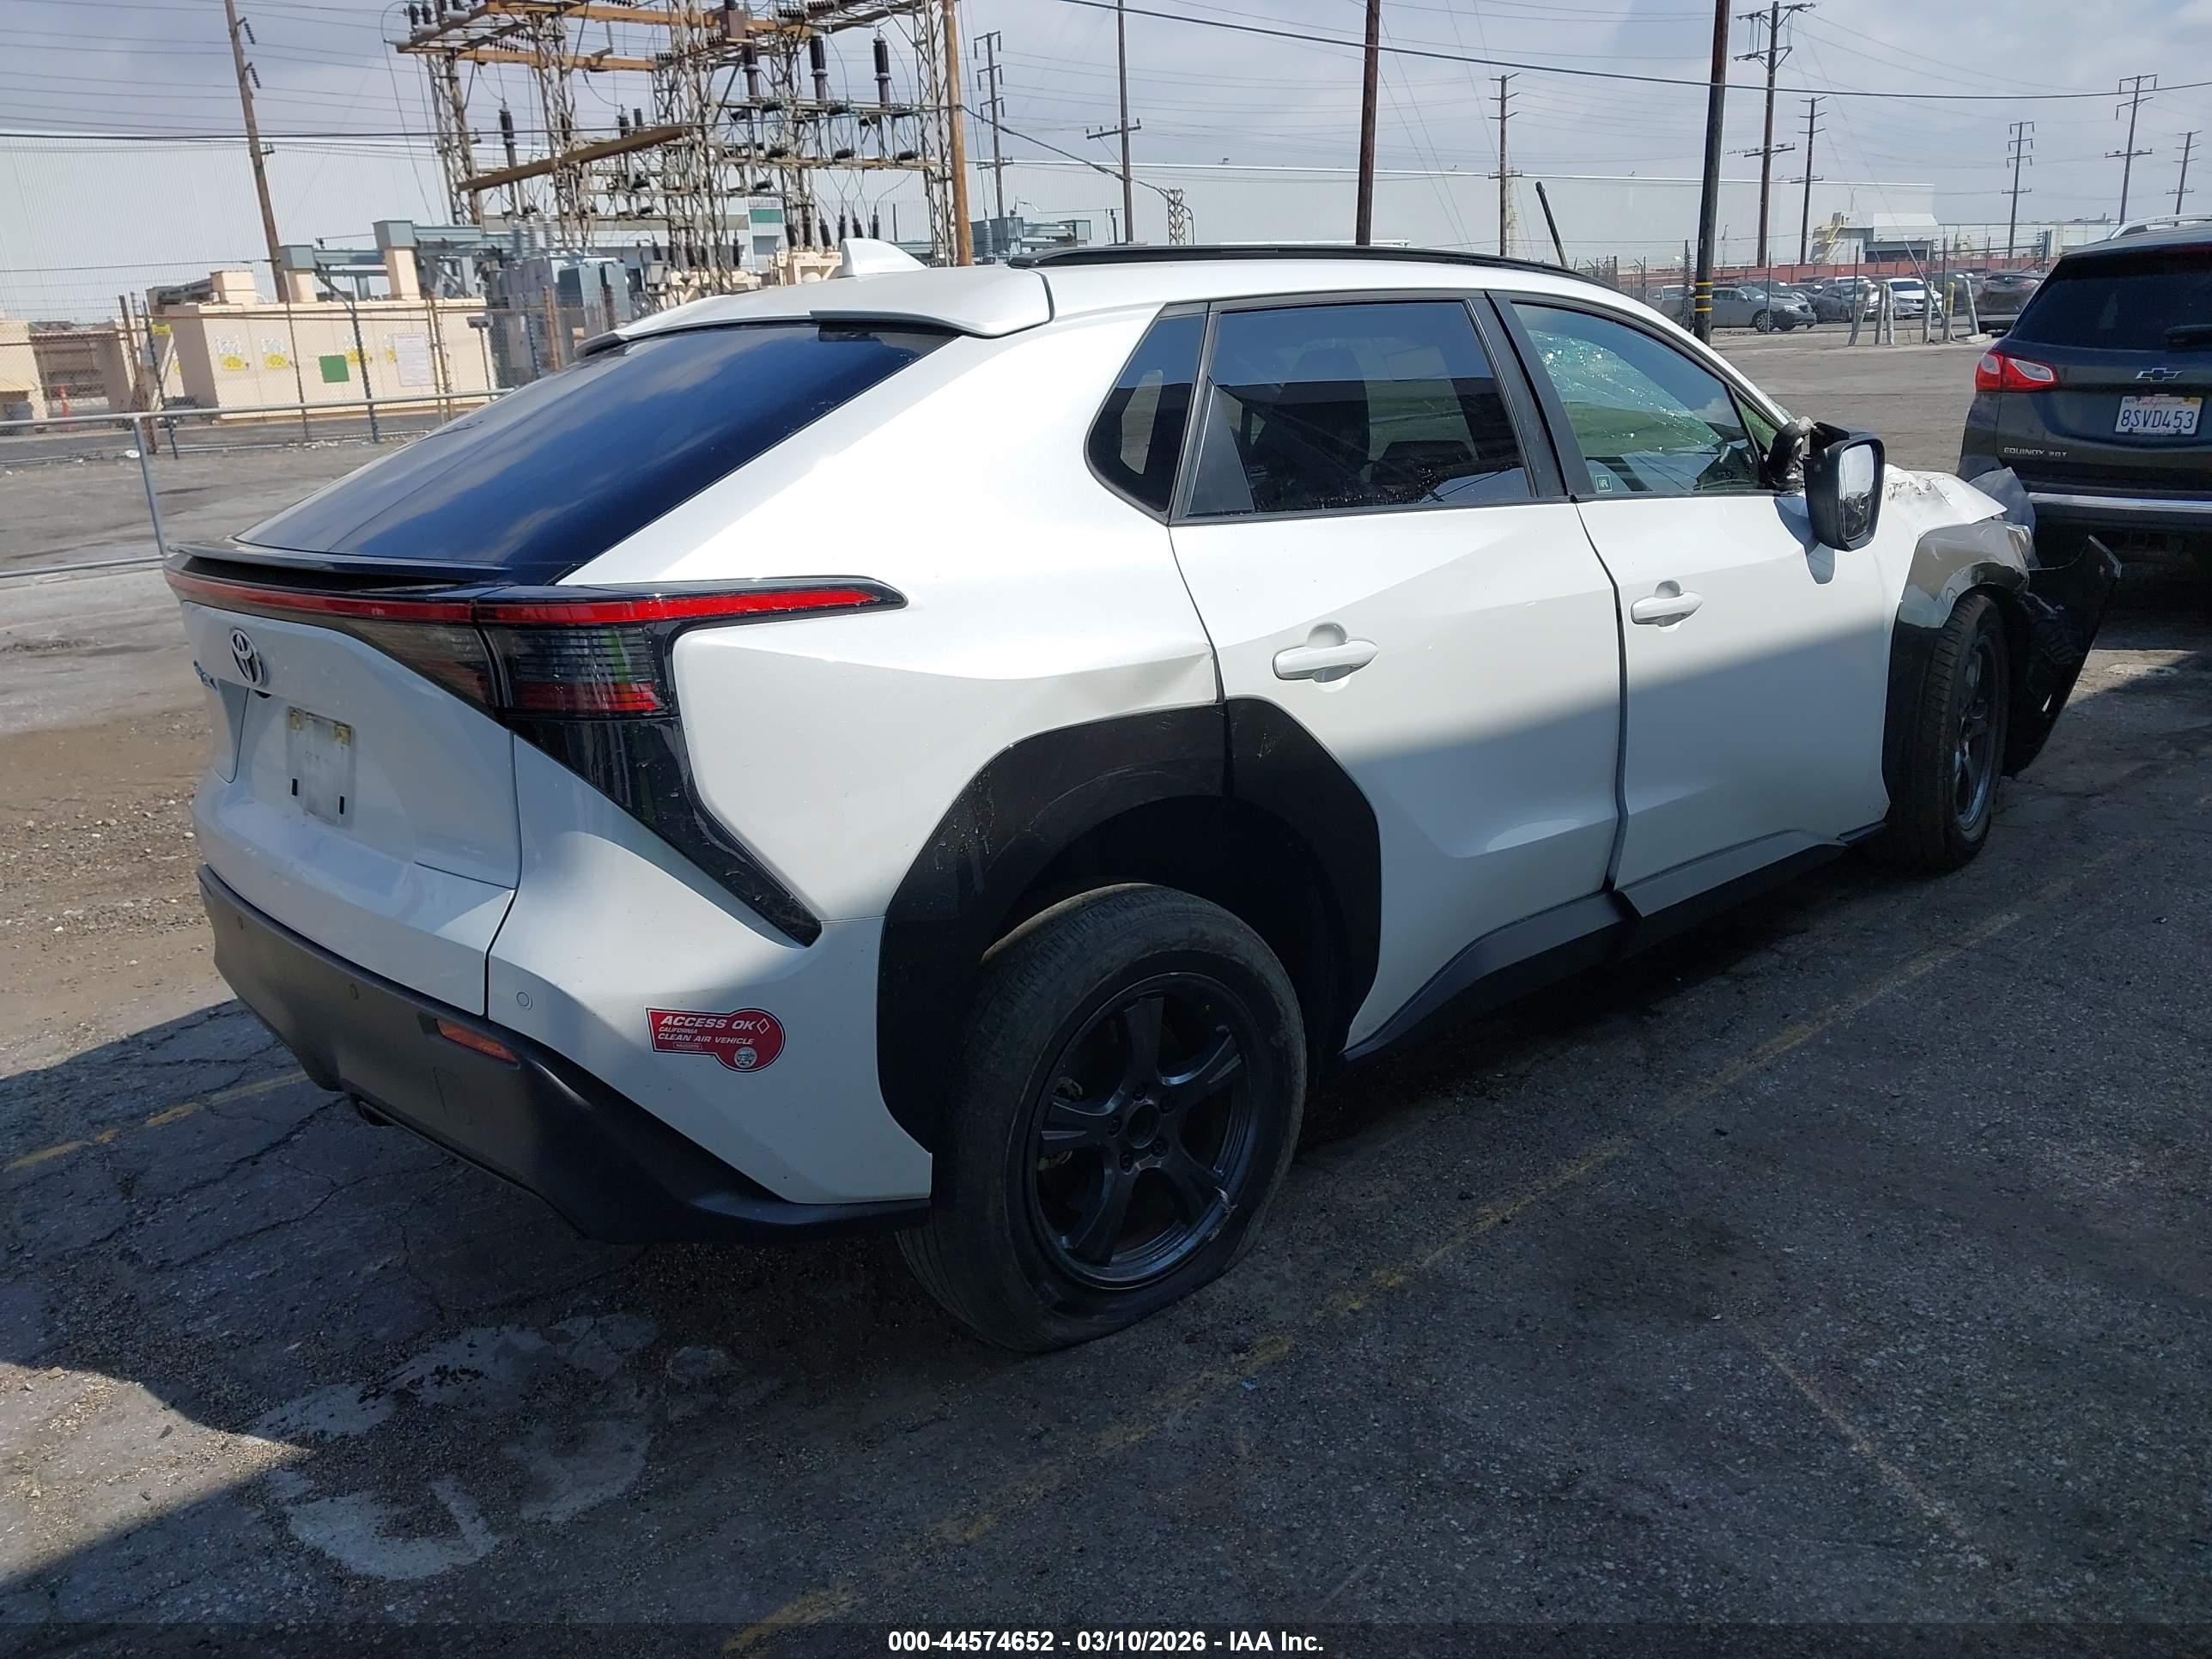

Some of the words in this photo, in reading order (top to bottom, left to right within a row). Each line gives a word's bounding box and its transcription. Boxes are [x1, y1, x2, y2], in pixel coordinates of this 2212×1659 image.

[2120, 409, 2195, 429] 8SVD453
[2003, 447, 2045, 455] EQUINOX
[659, 1016, 726, 1028] ACCESS
[732, 1020, 757, 1030] OK
